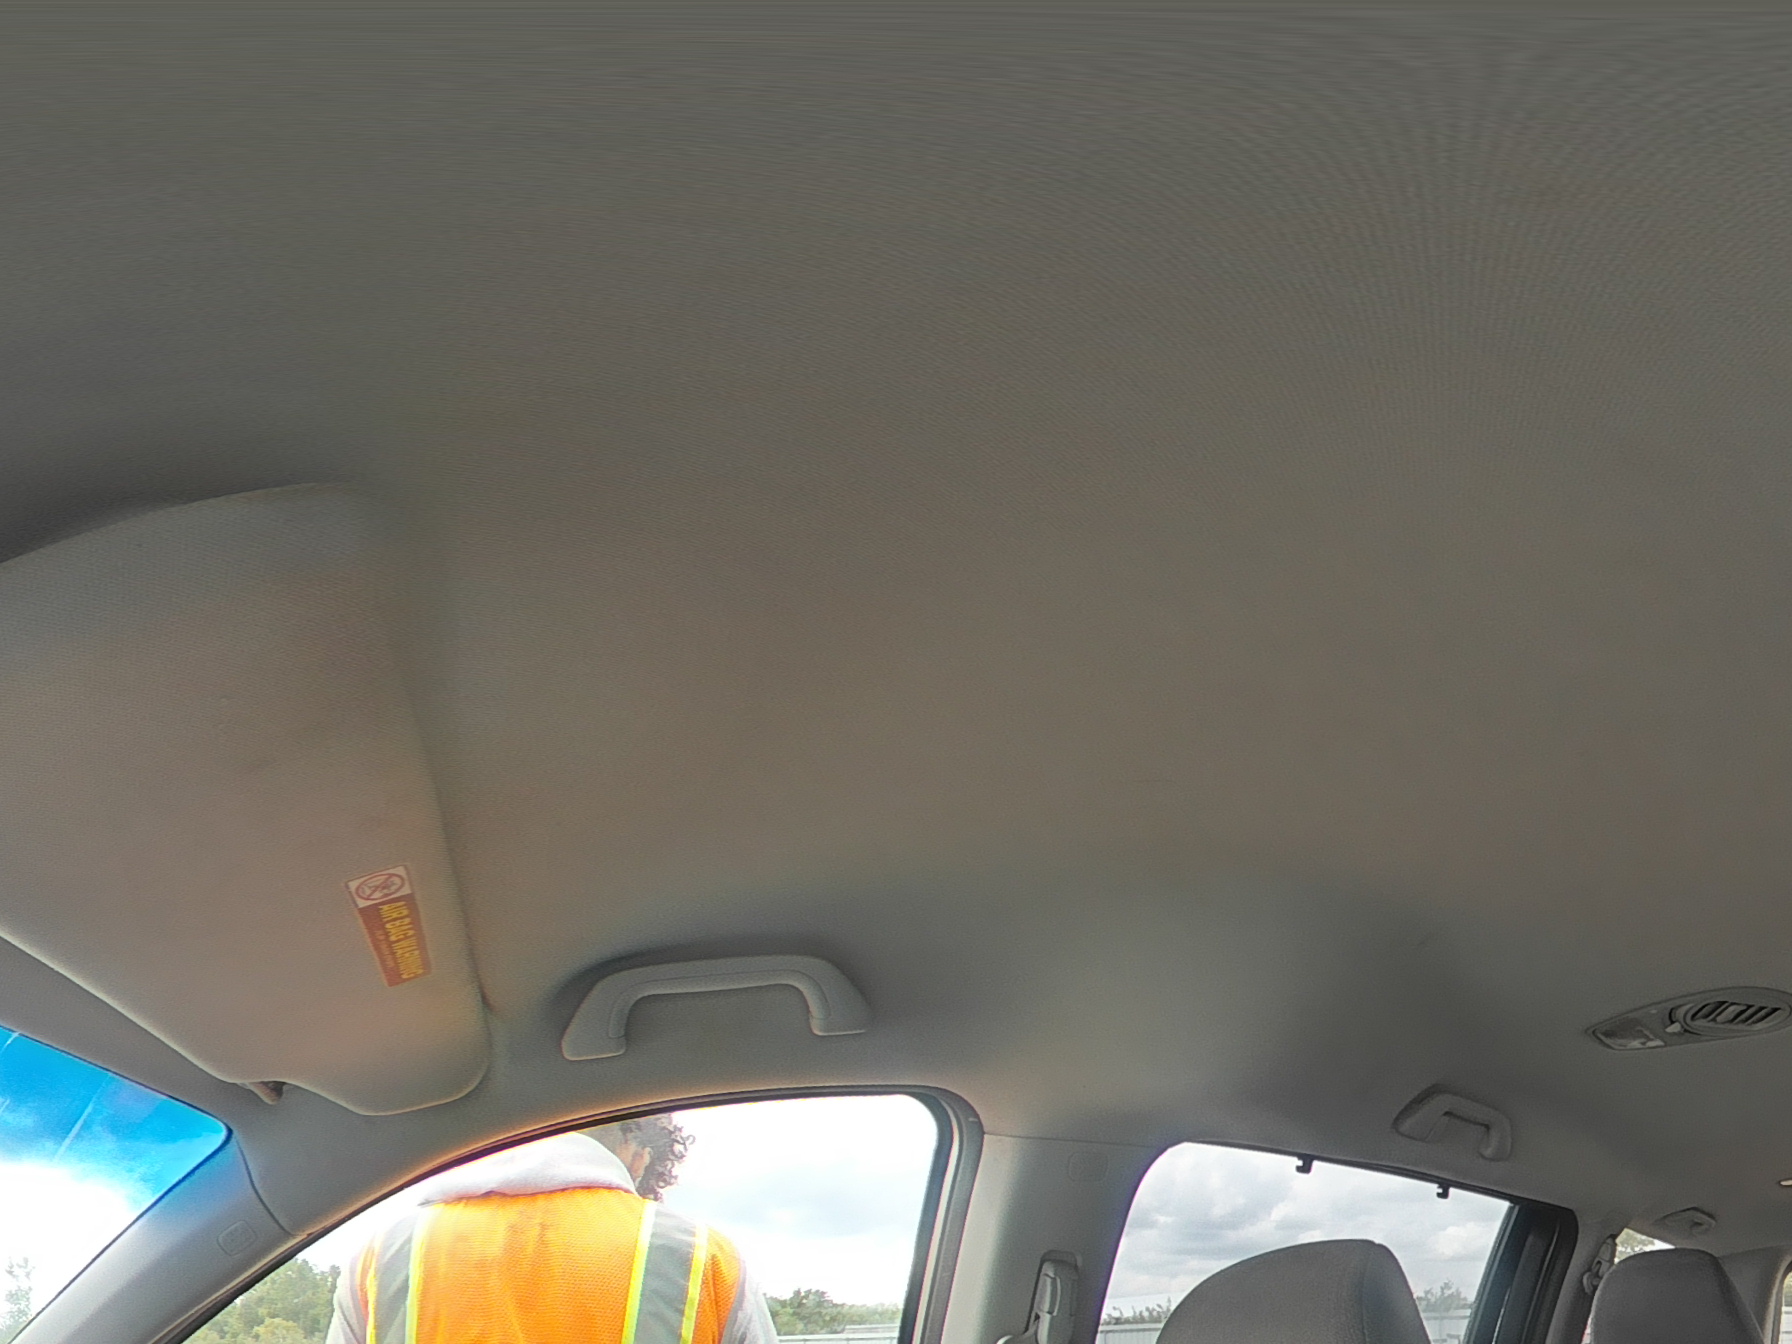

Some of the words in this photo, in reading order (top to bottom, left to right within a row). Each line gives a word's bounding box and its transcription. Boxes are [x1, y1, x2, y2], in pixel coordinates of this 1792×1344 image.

[378, 901, 409, 922] AIR
[385, 917, 416, 941] BAG
[392, 937, 424, 979] WARNING
